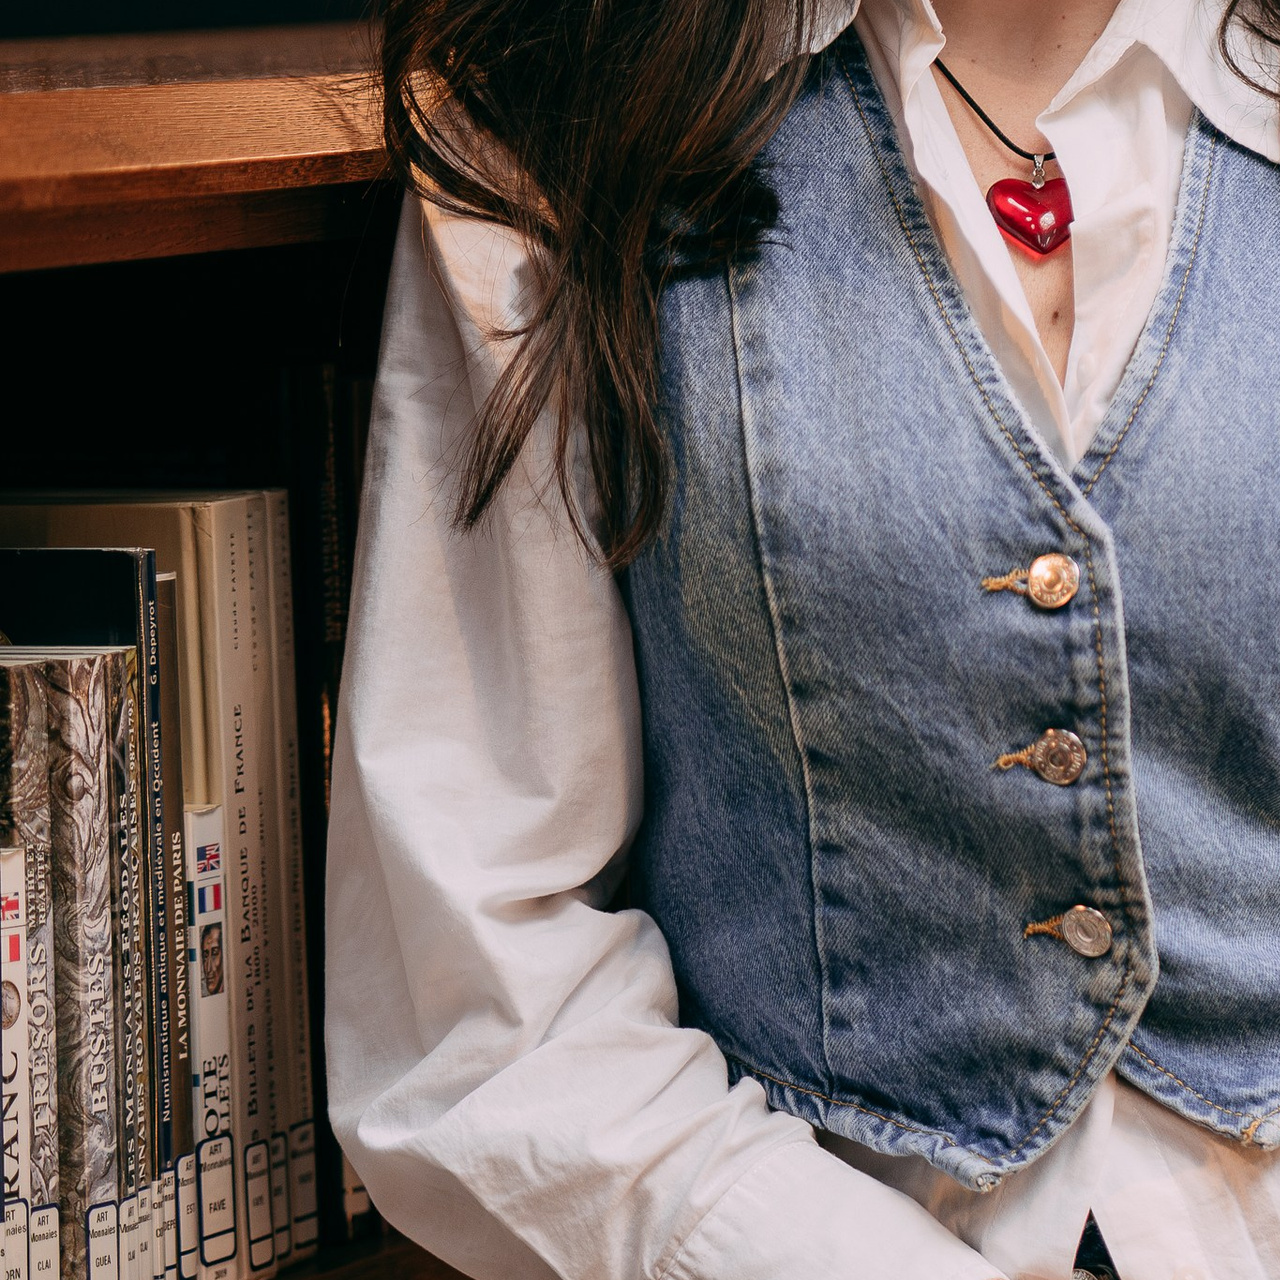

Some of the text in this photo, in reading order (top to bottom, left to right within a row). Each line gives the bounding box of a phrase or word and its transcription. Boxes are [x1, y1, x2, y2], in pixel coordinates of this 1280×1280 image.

[148, 600, 158, 685] G. Depeyrot
[234, 704, 244, 794] FRANCE
[154, 797, 162, 817] en
[239, 807, 247, 835] DE
[153, 823, 164, 905] médiévale
[171, 831, 182, 892] PARIS
[26, 865, 37, 928] MYTHE
[157, 910, 165, 927] et
[174, 896, 184, 925] DE
[240, 847, 251, 943] BANQUE
[251, 884, 259, 926] 2000
[127, 698, 146, 1182] NNAIES ROYALES FRANÇAISES 987-1793
[157, 932, 168, 993] antique
[175, 929, 187, 1028] MONNAIE
[245, 956, 252, 978] LA
[119, 794, 136, 1195] LES MONNAIES FÉODALES
[246, 986, 253, 1012] DE
[29, 942, 50, 1136] TRESORS
[87, 952, 108, 1115] BUSTES
[178, 1032, 188, 1060] LA
[160, 1000, 172, 1122] Numismatique
[247, 1024, 258, 1117] BILLETS
[209, 1143, 222, 1155] ART
[37, 1214, 49, 1227] ART
[89, 1226, 116, 1239] Monnaies
[96, 1211, 108, 1222] ART
[37, 1259, 51, 1271] CLAI
[95, 1254, 112, 1267] GUEA
